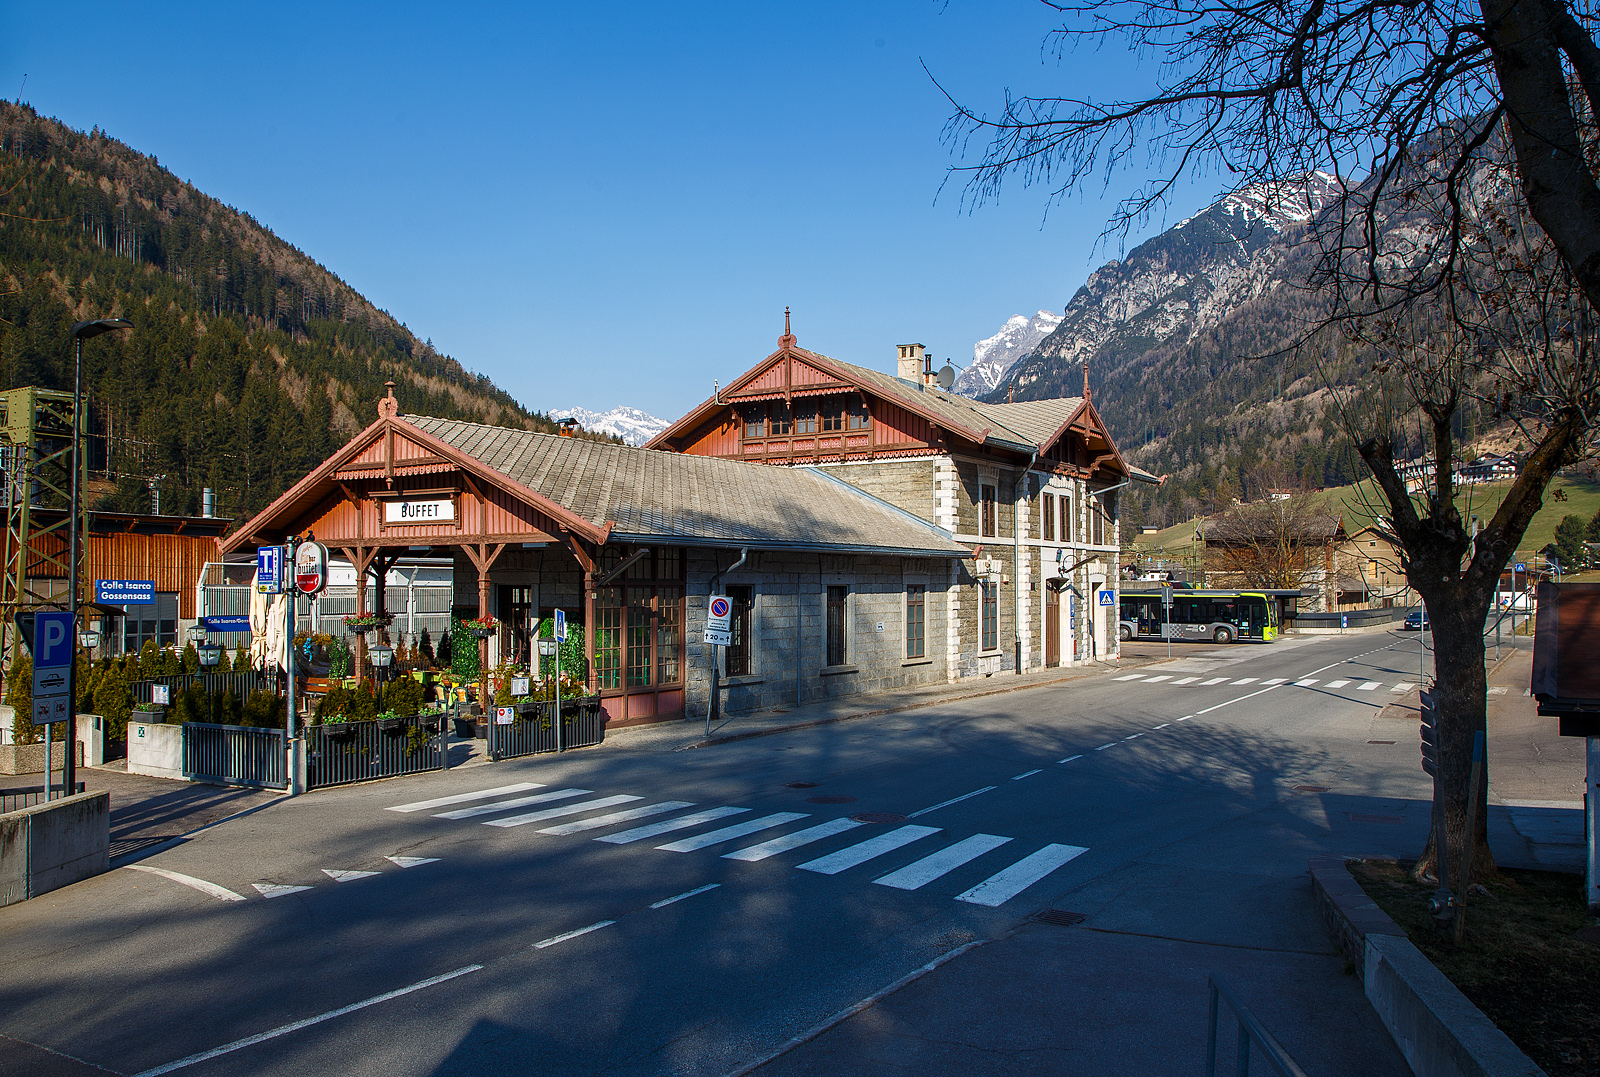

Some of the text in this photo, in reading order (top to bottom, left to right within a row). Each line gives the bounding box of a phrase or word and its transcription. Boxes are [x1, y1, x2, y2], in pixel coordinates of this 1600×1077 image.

[402, 504, 439, 517] BUFFET
[259, 550, 272, 573] T
[298, 562, 317, 574] buffet
[101, 581, 152, 590] Colle Isarco
[101, 591, 151, 600] Gossensass
[43, 619, 66, 660] P
